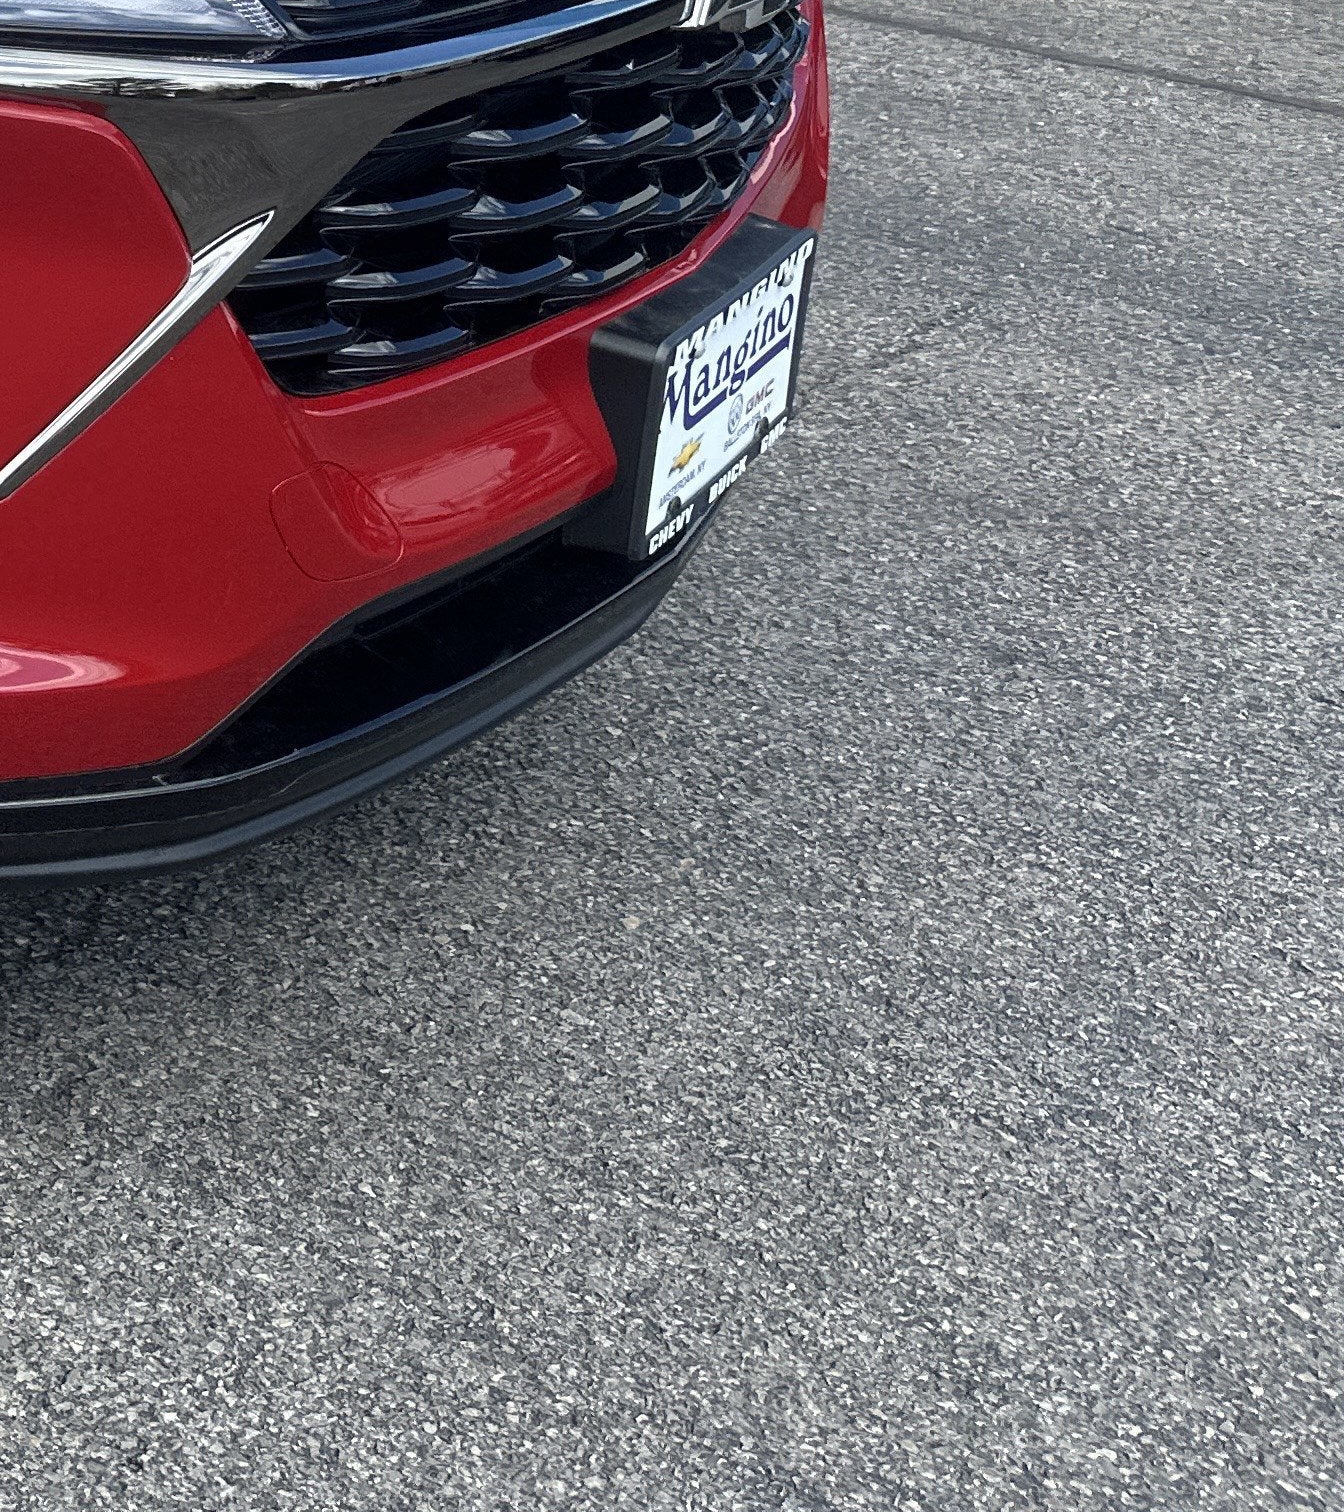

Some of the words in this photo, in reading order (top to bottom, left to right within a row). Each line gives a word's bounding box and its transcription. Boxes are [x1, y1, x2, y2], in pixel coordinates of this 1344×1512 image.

[663, 293, 795, 430] Mangino
[673, 238, 814, 365] MANGINO
[746, 377, 775, 415] GMC
[648, 504, 694, 555] CHEVY
[708, 455, 748, 504] BUICK
[760, 416, 788, 455] GMC
